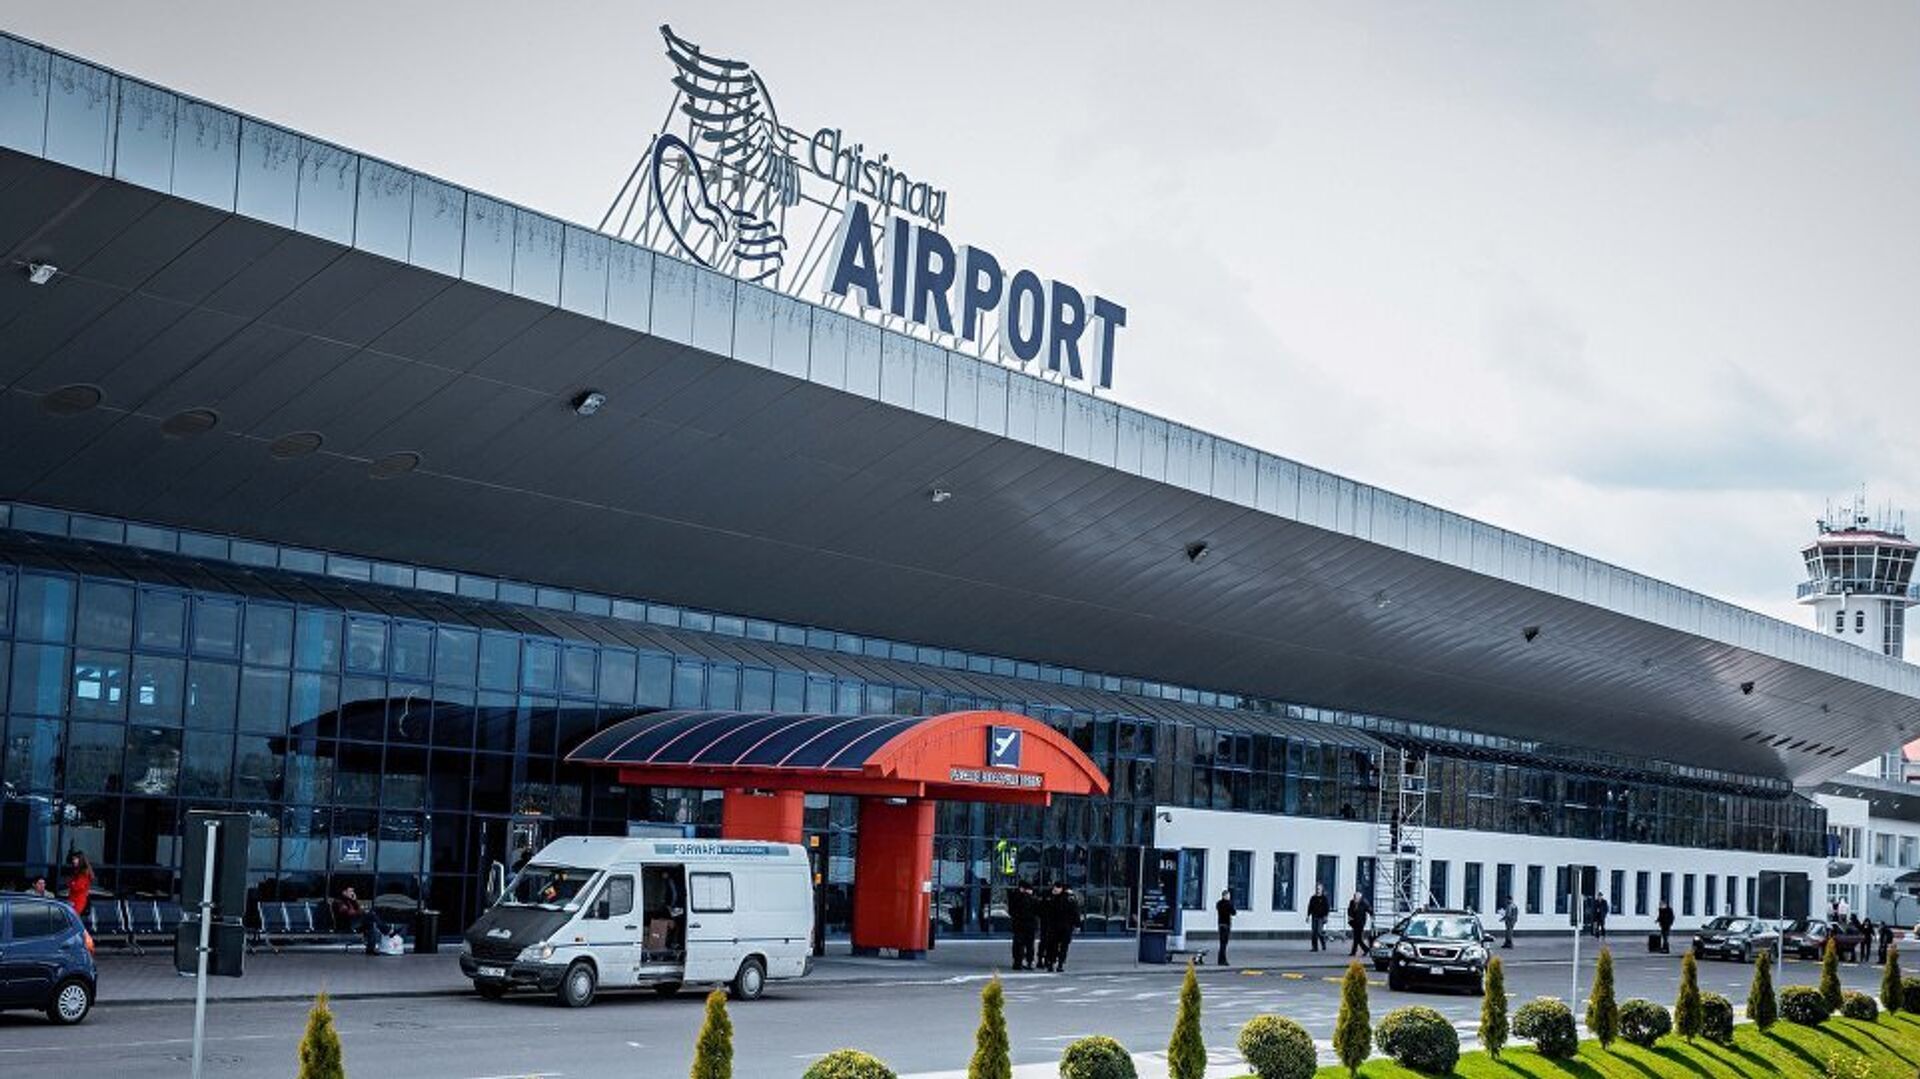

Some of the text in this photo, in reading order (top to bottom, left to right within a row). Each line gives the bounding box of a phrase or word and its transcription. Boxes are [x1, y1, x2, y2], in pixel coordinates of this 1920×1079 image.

[810, 128, 947, 226] Chisinau
[828, 200, 1127, 390] AIRPORT
[673, 844, 722, 855] FORWARD
